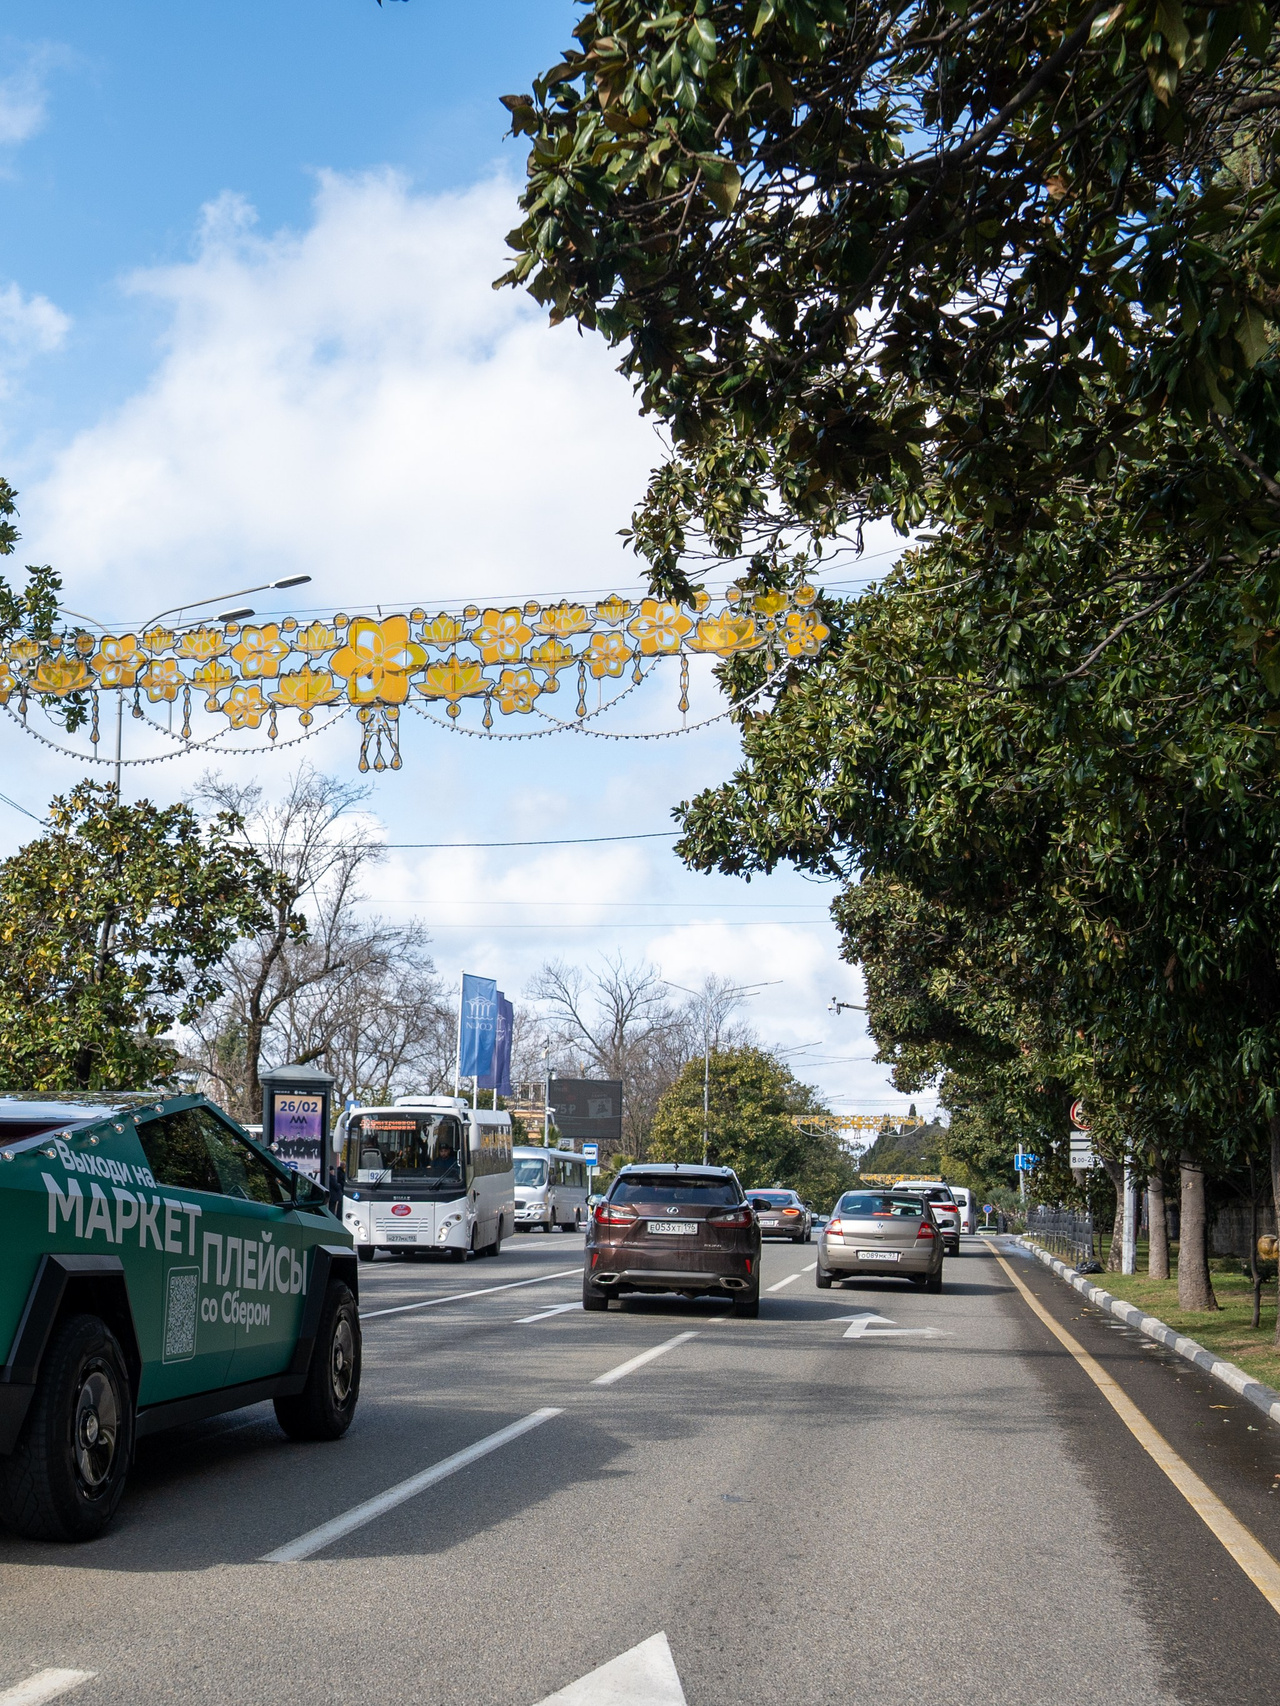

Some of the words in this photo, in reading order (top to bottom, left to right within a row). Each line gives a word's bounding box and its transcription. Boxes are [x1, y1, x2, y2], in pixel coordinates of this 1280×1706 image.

[280, 1100, 318, 1113] 26/02
[553, 1103, 566, 1114] 75
[54, 1139, 133, 1187] Выходи
[131, 1165, 157, 1188] на
[370, 1172, 379, 1180] 92
[41, 1172, 202, 1256] МАРКЕТ
[650, 1223, 682, 1231] Е053ХТ
[202, 1231, 308, 1295] ПЛЕЙСЫ
[201, 1297, 218, 1322] со
[221, 1290, 270, 1333] Сбером
